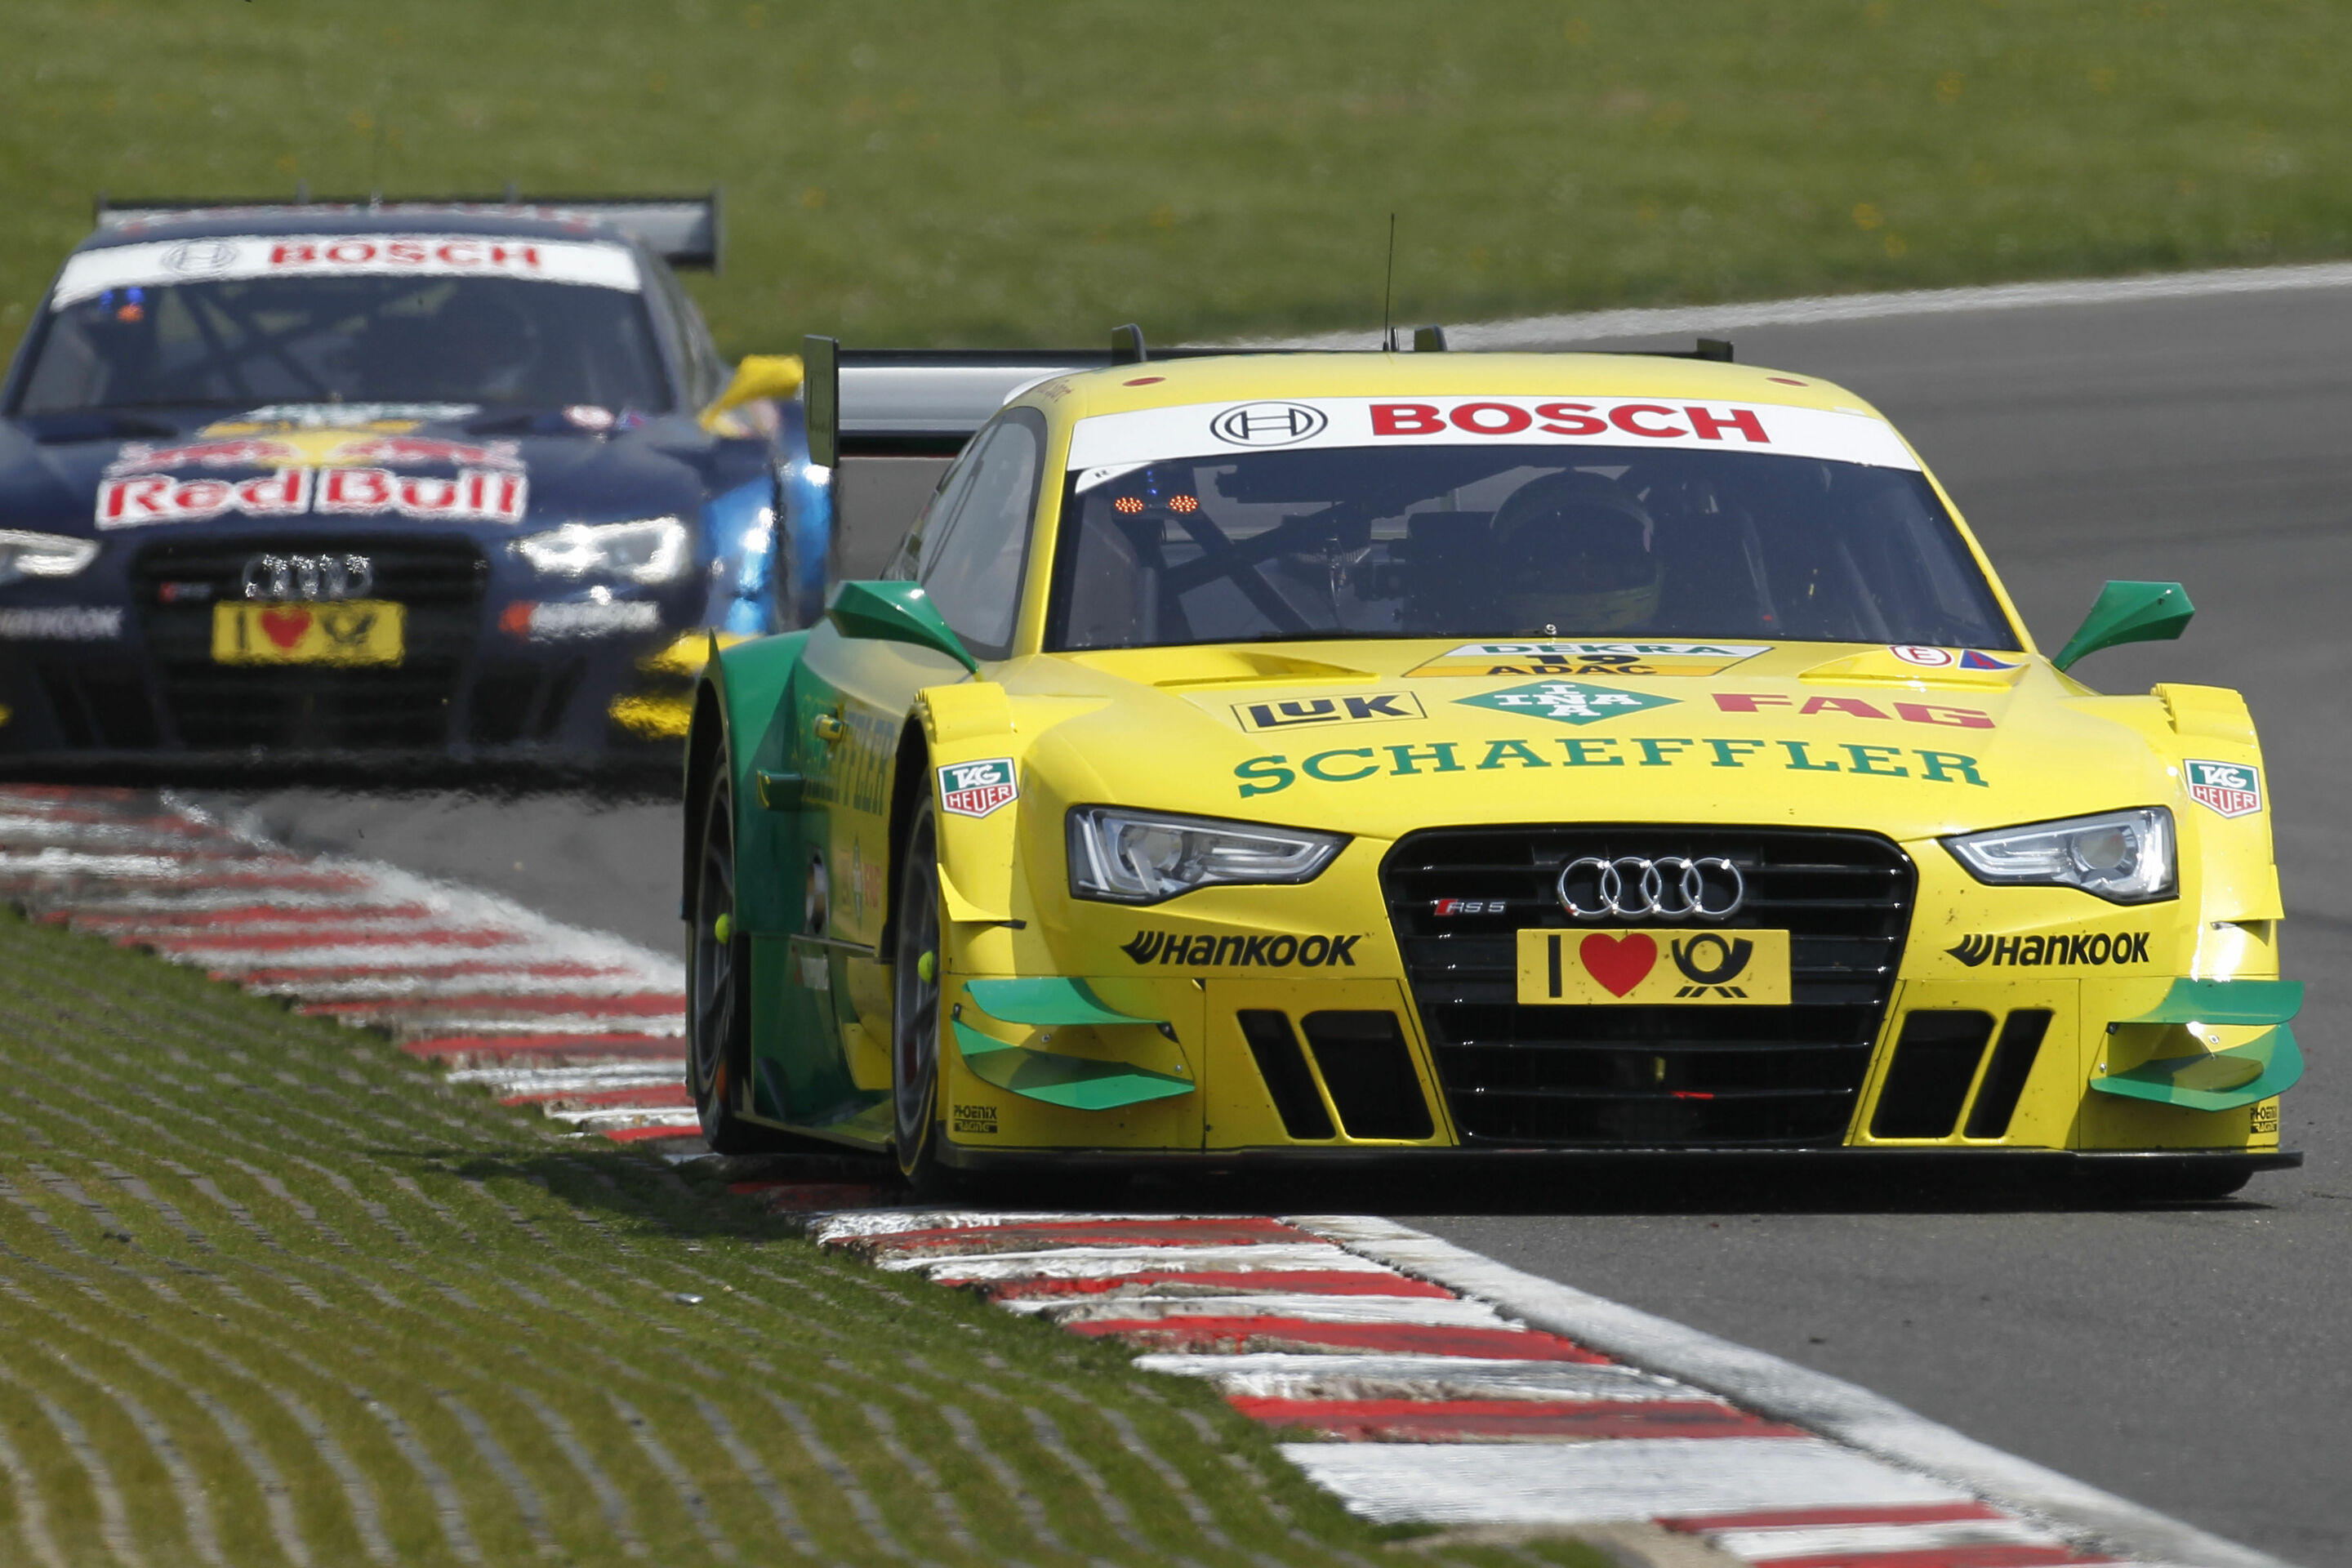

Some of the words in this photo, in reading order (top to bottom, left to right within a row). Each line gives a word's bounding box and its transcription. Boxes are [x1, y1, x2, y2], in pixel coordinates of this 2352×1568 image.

[270, 239, 542, 267] BOSCH
[1369, 403, 1771, 443] BOSCH
[106, 466, 302, 518] Red
[325, 467, 518, 514] Bull
[1481, 644, 1737, 654] DEKRA
[1525, 655, 1641, 665] 19
[1486, 664, 1658, 675] ADAC
[1710, 693, 1996, 729] FAG
[951, 764, 1002, 789] TAG
[1233, 738, 1989, 799] SCHAEFFLER
[2198, 765, 2247, 789] TAG
[948, 786, 1011, 813] HEUER
[2195, 786, 2256, 813] HEUER
[1548, 934, 1562, 999] I
